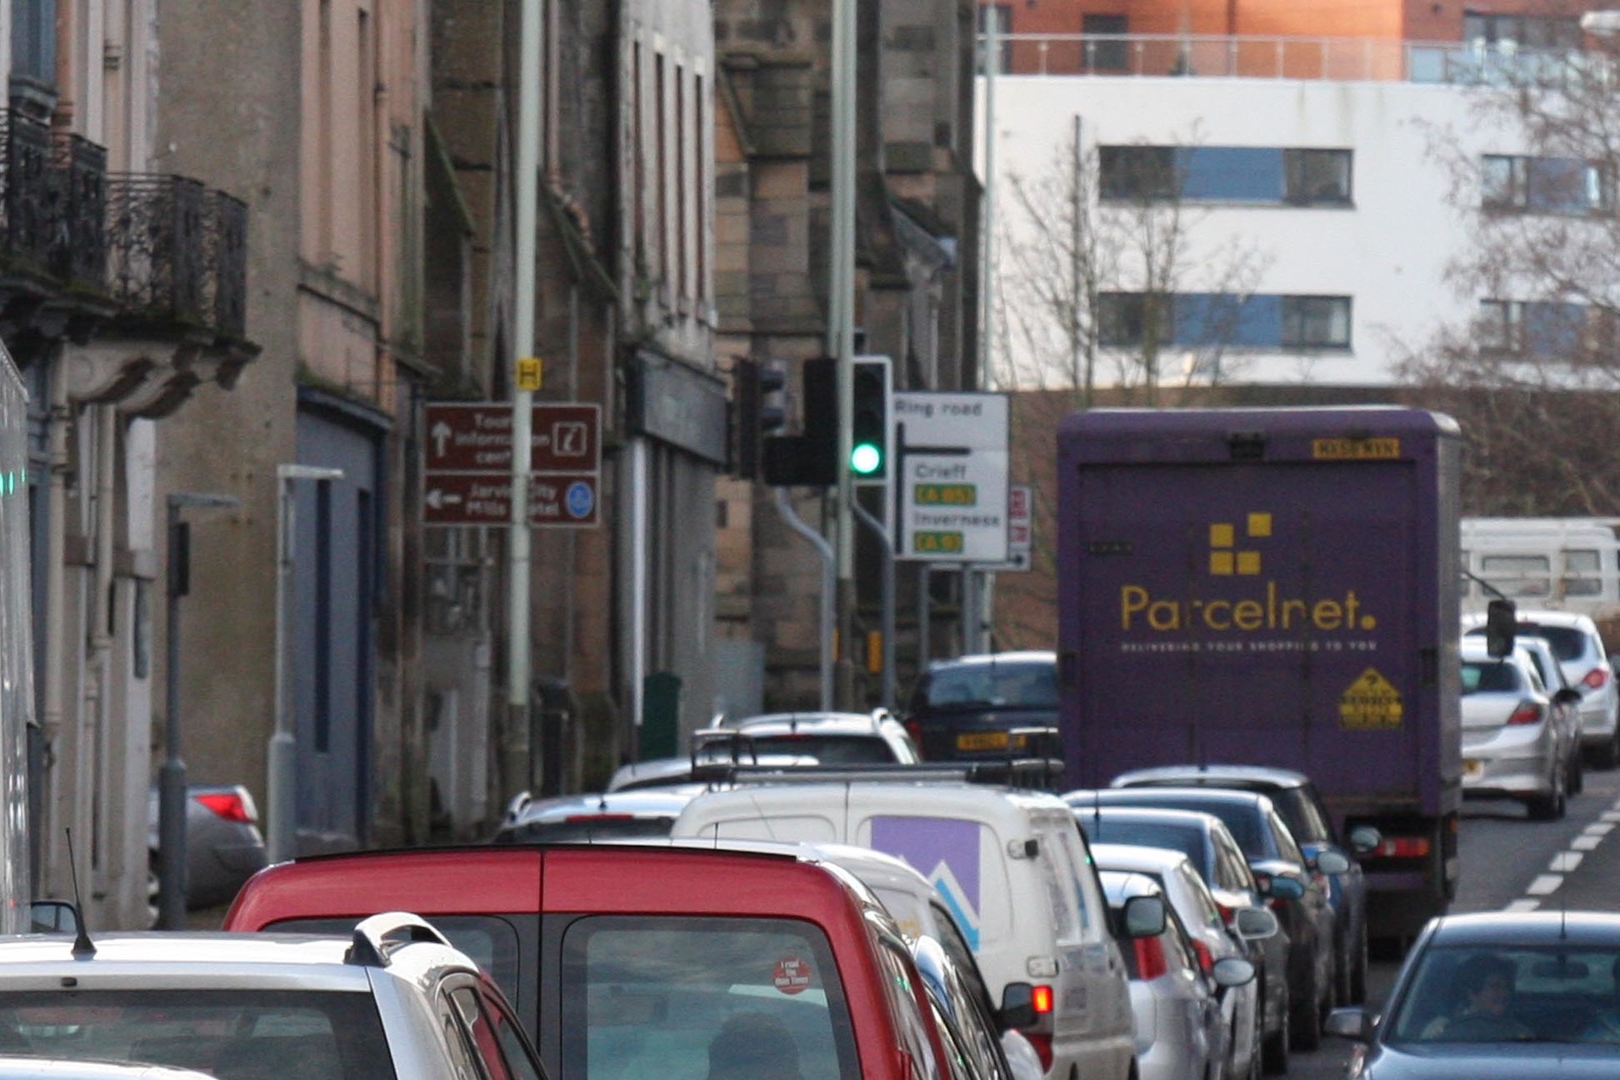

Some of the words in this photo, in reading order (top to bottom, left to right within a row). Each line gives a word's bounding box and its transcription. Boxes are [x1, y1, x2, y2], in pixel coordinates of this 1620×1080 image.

[894, 401, 933, 418] Ring
[943, 402, 982, 416] road
[914, 512, 1000, 527] Inverness
[1121, 580, 1376, 630] Parcelnet.
